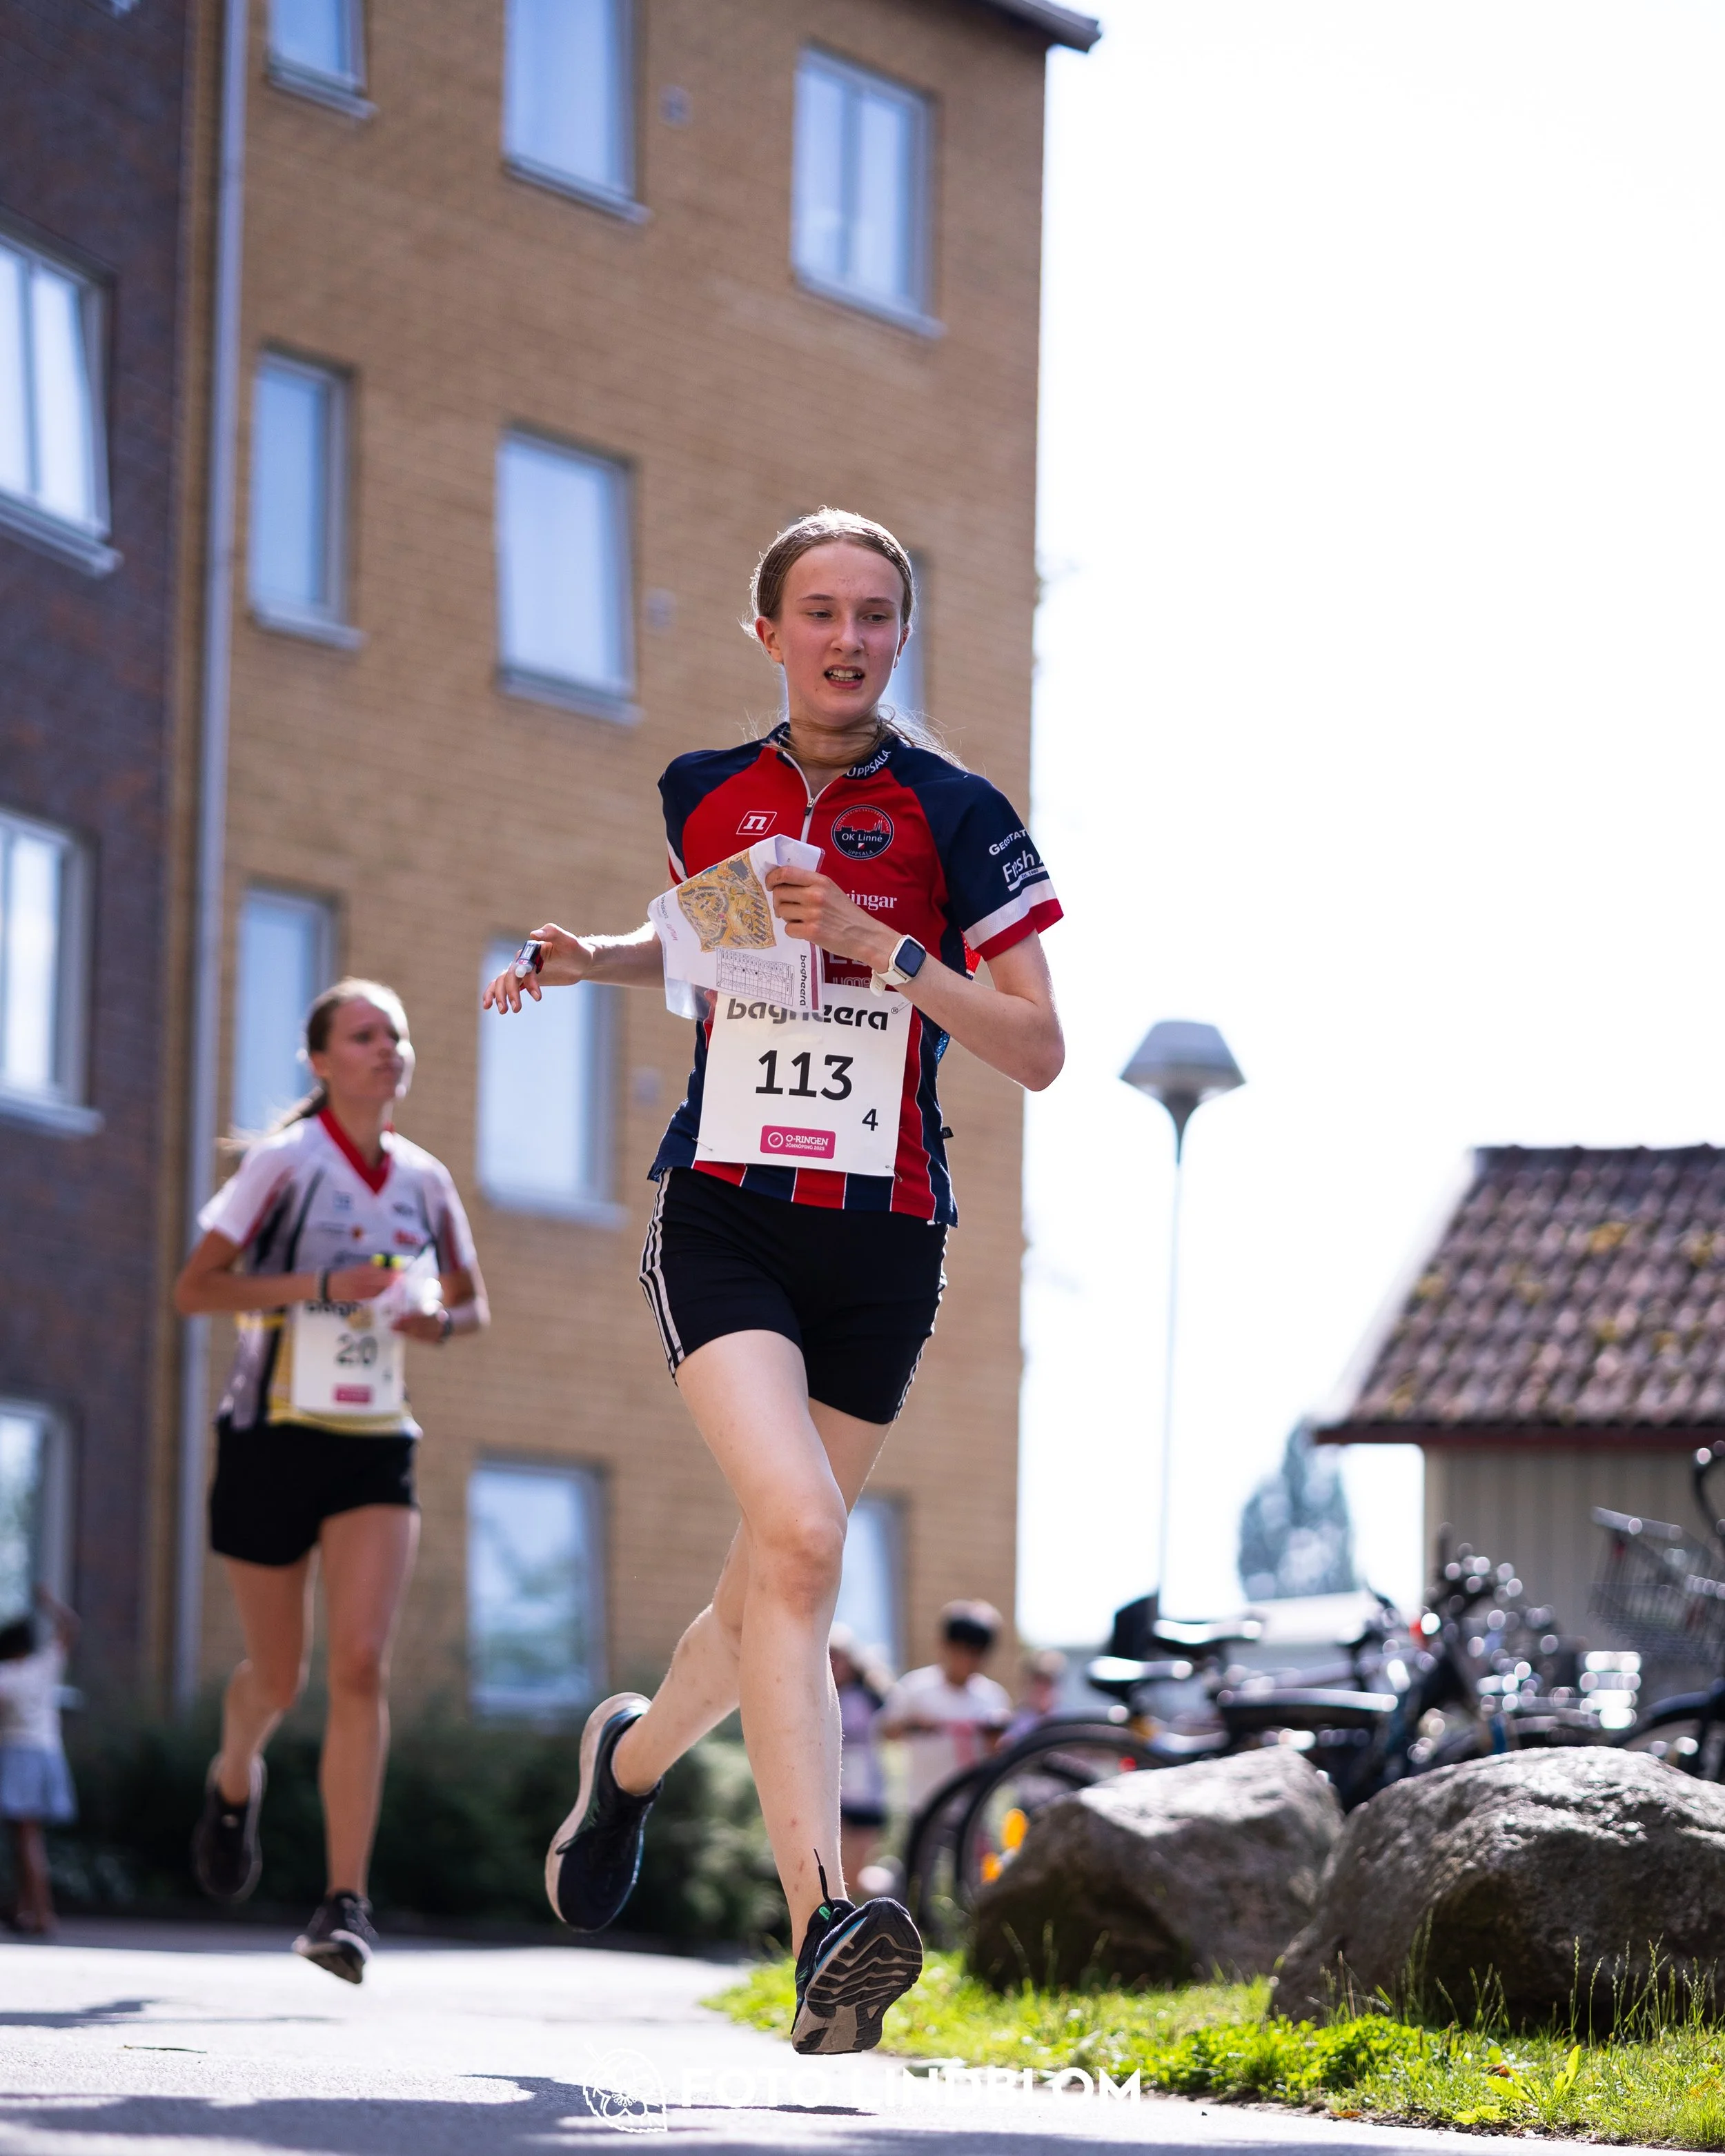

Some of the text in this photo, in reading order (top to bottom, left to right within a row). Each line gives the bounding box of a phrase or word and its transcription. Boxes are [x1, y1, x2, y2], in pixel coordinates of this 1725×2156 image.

[847, 750, 891, 777] UPPSALA
[842, 833, 883, 842] OK Linné
[847, 890, 898, 911] ingar
[755, 1049, 854, 1101] 113
[861, 1108, 879, 1131] 4
[785, 1134, 829, 1146] O-RINGEN
[335, 1332, 379, 1367] 20
